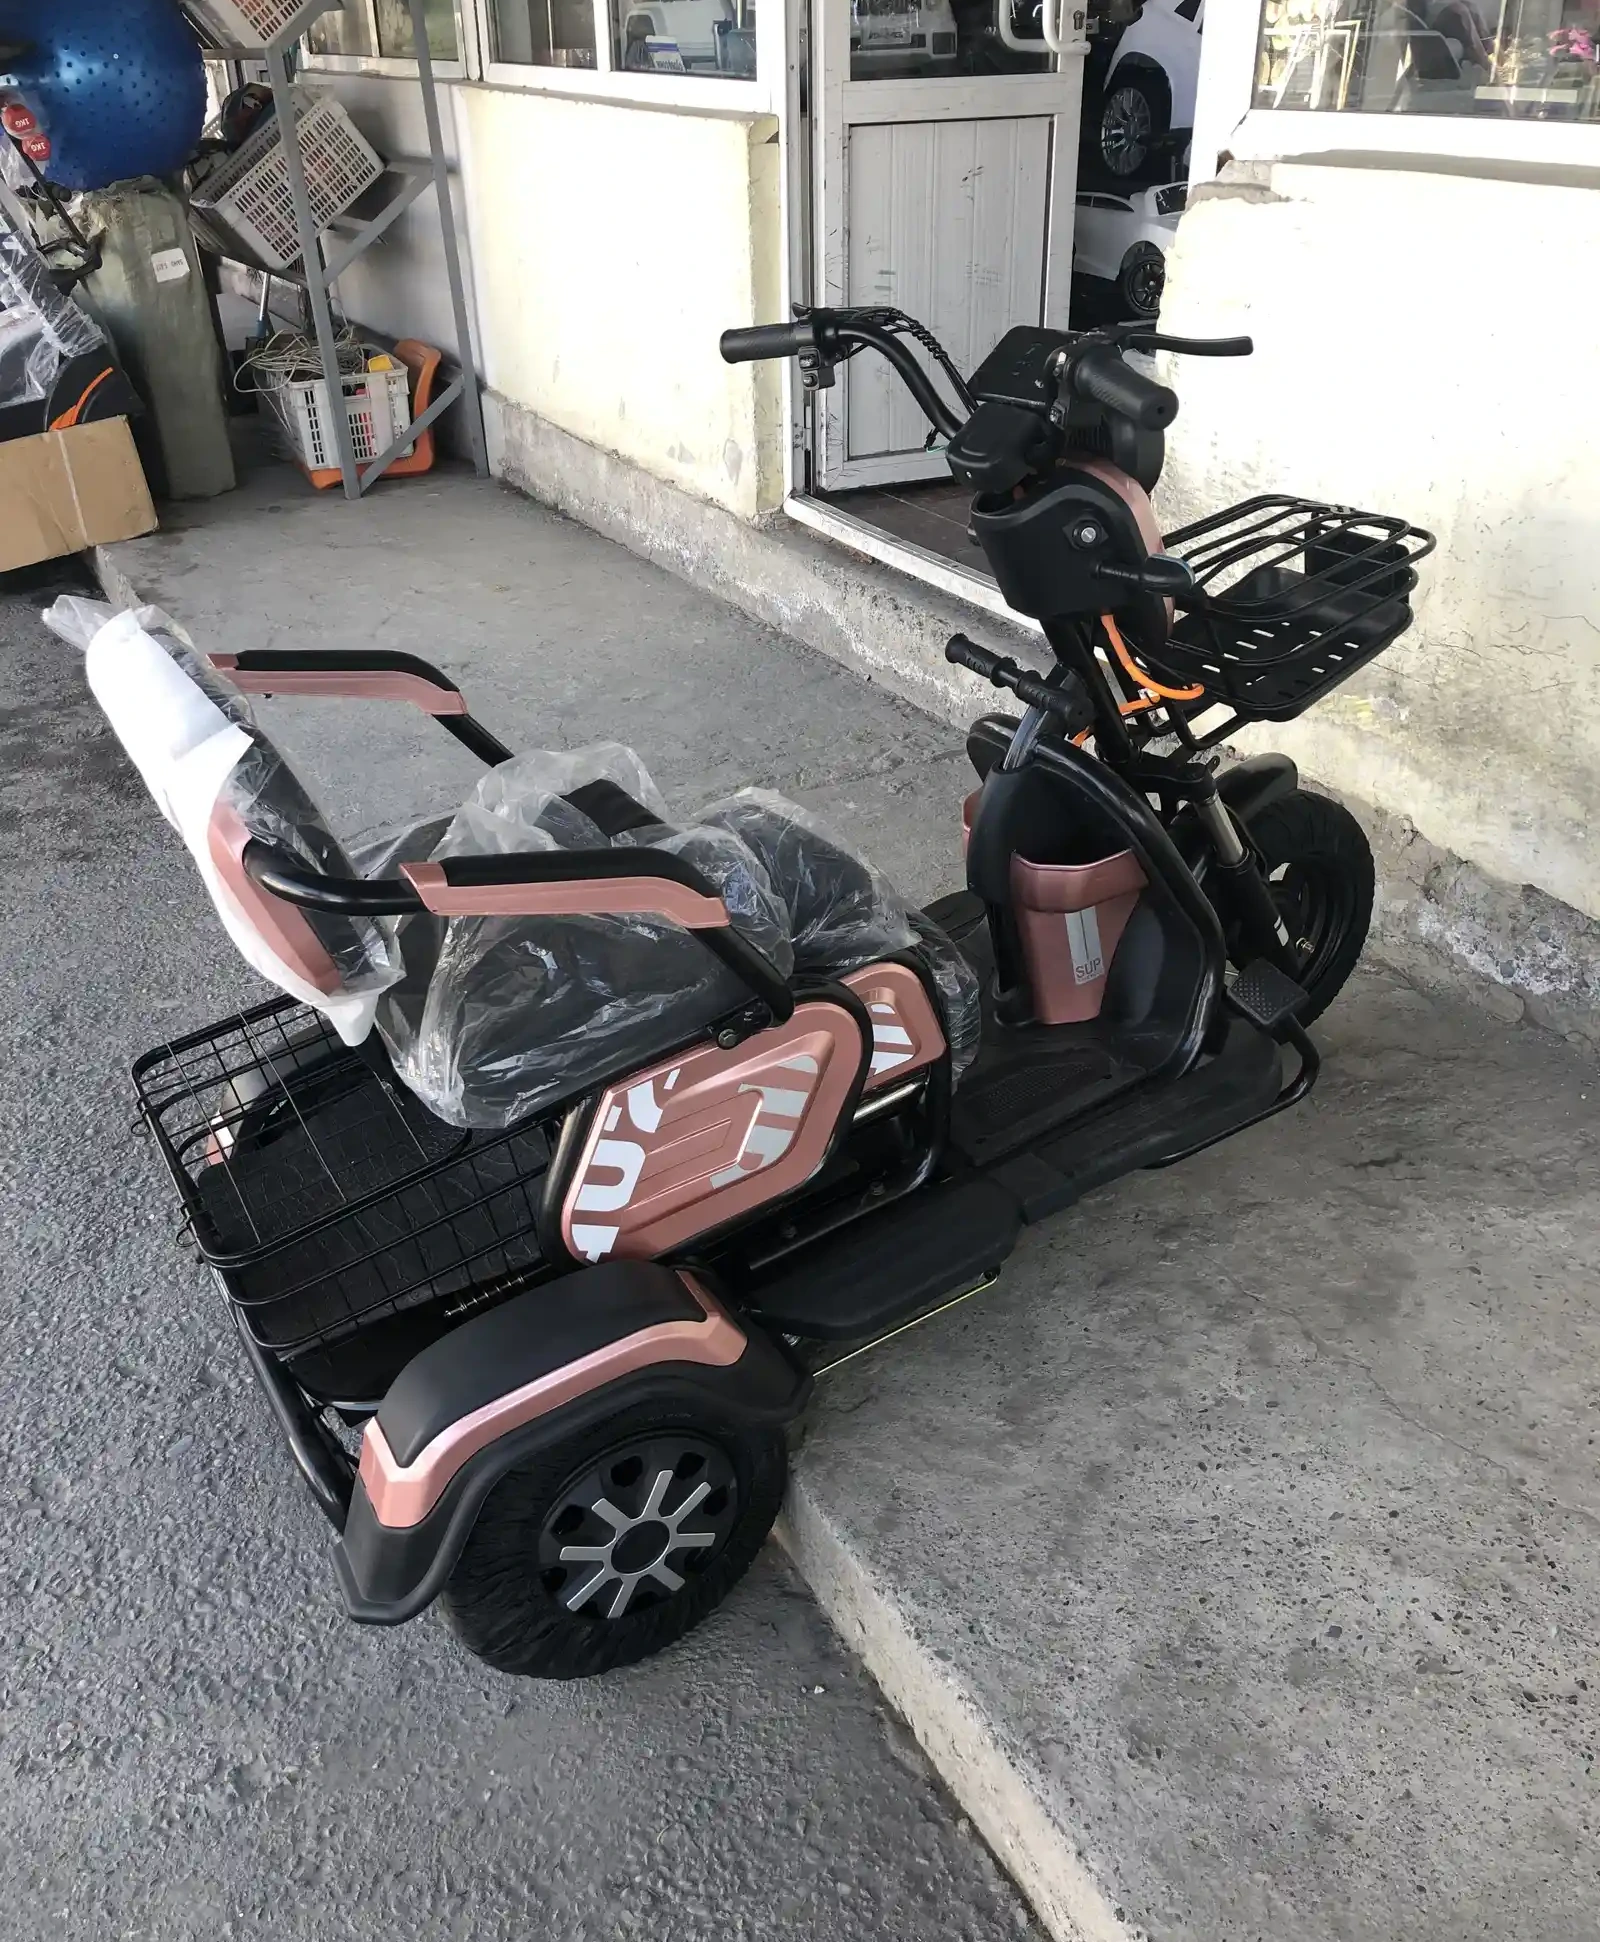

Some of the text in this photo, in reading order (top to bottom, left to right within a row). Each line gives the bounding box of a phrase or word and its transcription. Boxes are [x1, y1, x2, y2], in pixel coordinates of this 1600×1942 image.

[15, 117, 30, 128] 1KG
[30, 142, 46, 152] 1KG
[1075, 958, 1101, 978] SUP
